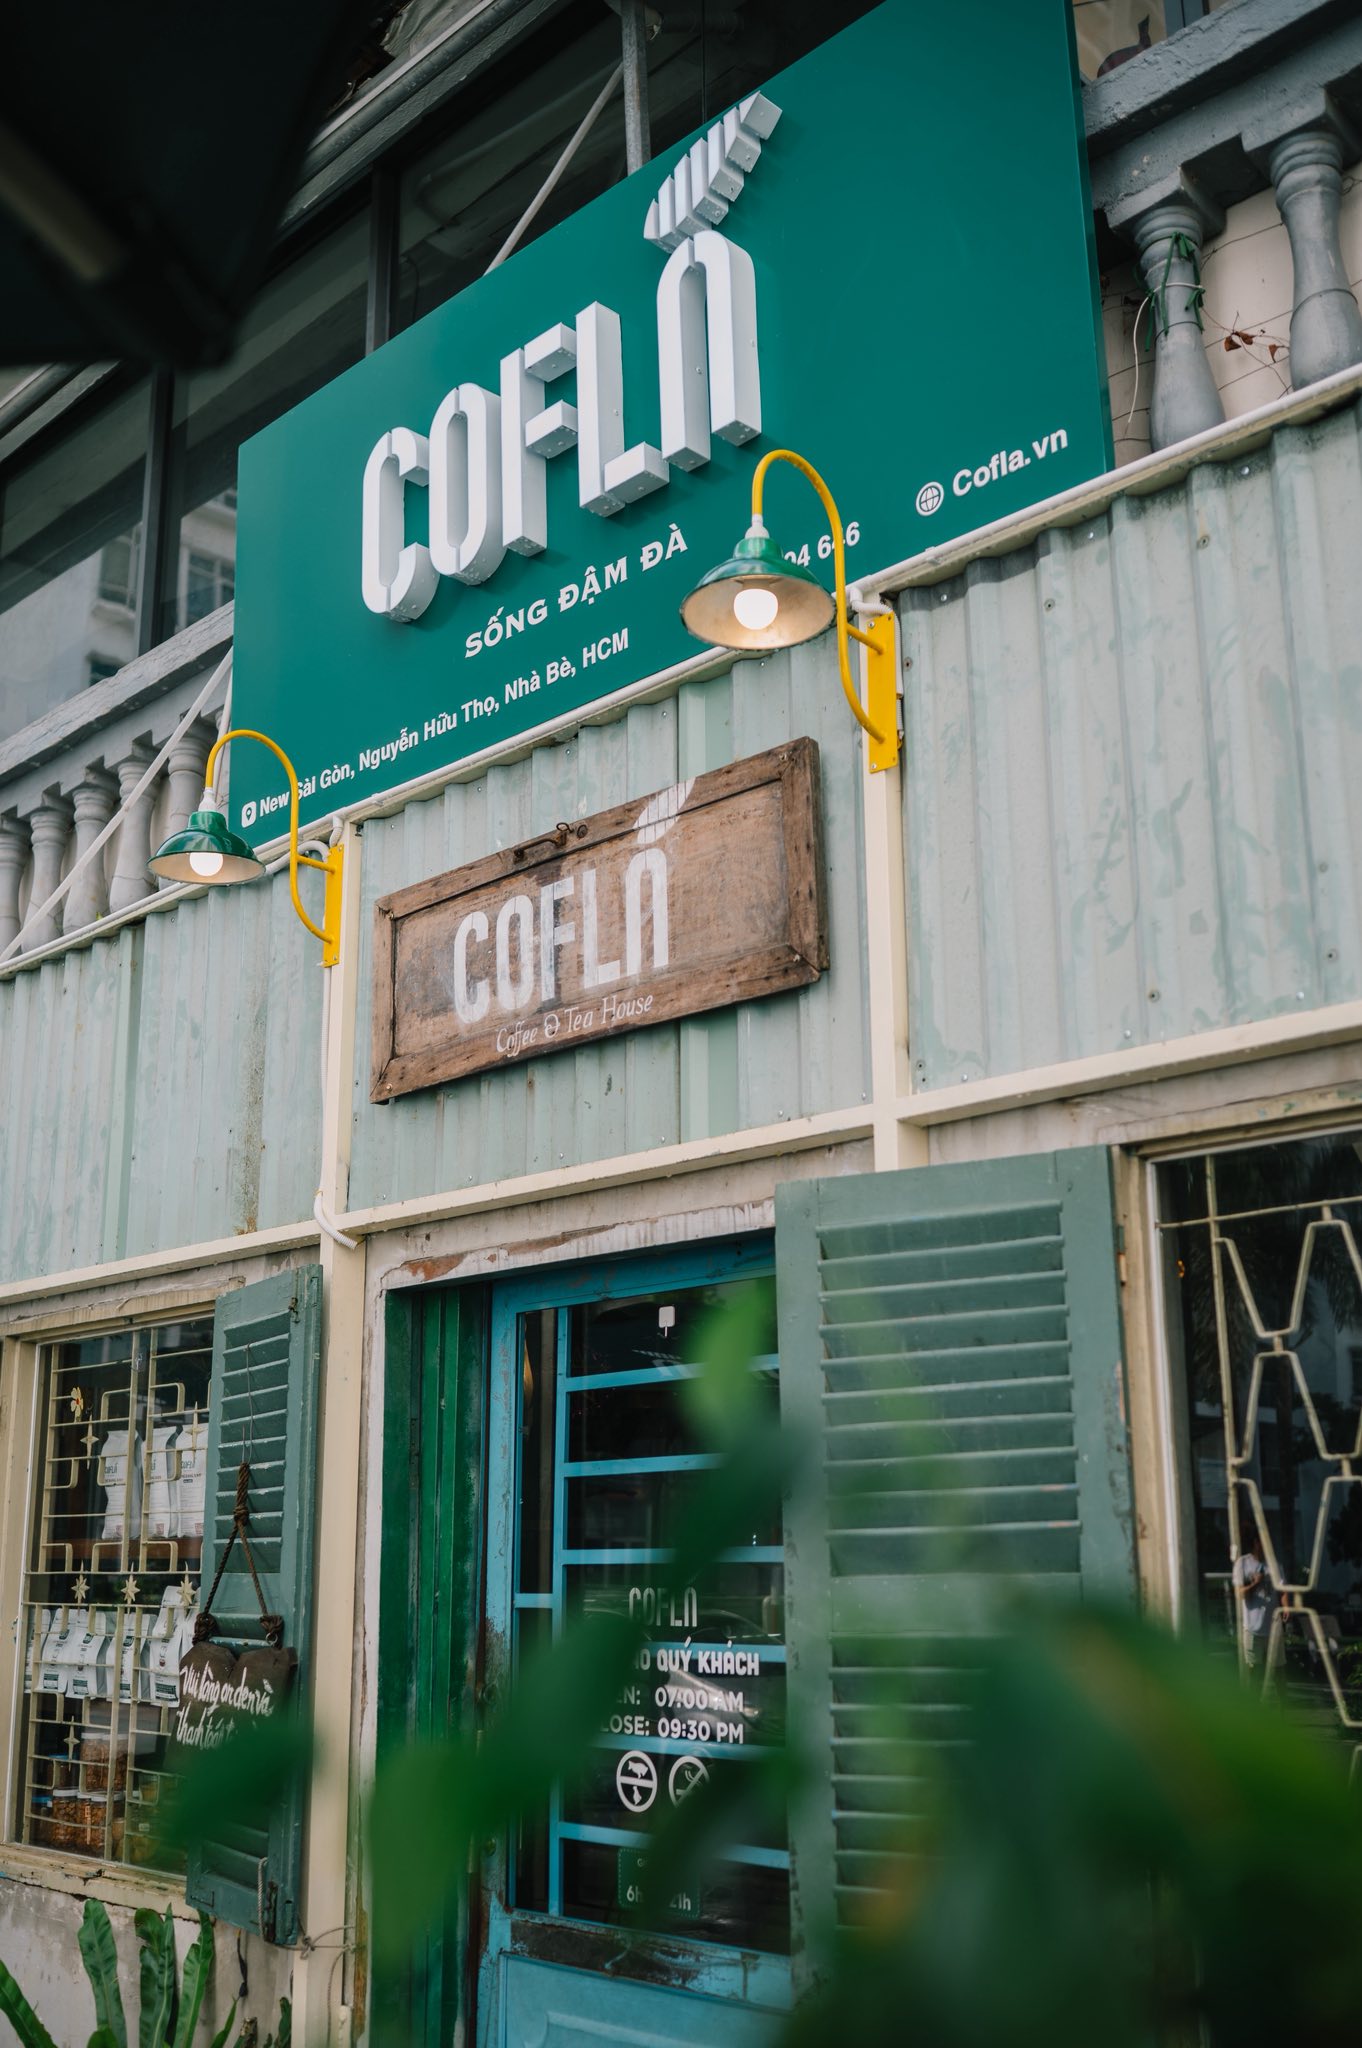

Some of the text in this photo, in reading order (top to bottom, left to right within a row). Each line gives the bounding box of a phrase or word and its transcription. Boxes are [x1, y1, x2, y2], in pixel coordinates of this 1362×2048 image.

[951, 428, 1068, 497] Cofla.vn
[817, 521, 860, 559] 66
[465, 523, 688, 658] SỐNG ĐẬM ĐÀ
[259, 791, 290, 818] New
[320, 763, 355, 790] Gòn,
[359, 727, 419, 771] Nguyễn
[423, 712, 458, 742] Hữu
[461, 695, 500, 723] Thọ,
[504, 670, 541, 704] Nhà
[546, 656, 576, 685] Bè,
[582, 627, 629, 668] HCM
[496, 1018, 538, 1058] Coffee
[565, 1006, 594, 1033] Tea
[601, 994, 654, 1025] House
[656, 1635, 692, 1673] QUÝ
[697, 1639, 760, 1676] KHÁCH
[655, 1686, 709, 1710] 07:00
[714, 1690, 745, 1713] AM
[601, 1714, 745, 1745] OSE: 09:30 PM
